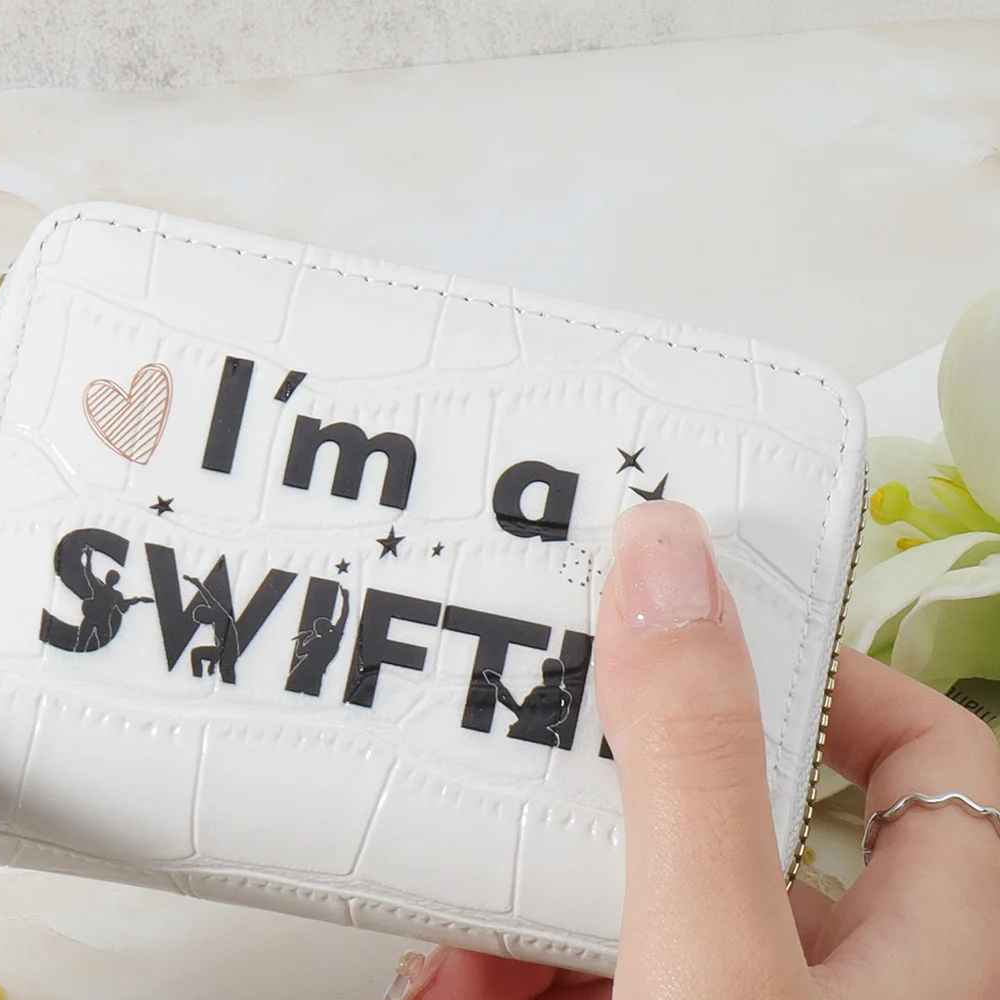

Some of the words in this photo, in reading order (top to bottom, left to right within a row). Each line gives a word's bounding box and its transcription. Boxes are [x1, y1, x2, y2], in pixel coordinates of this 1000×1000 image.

[203, 356, 417, 508] I'm
[492, 461, 579, 542] a
[39, 528, 615, 760] SWIFTI
